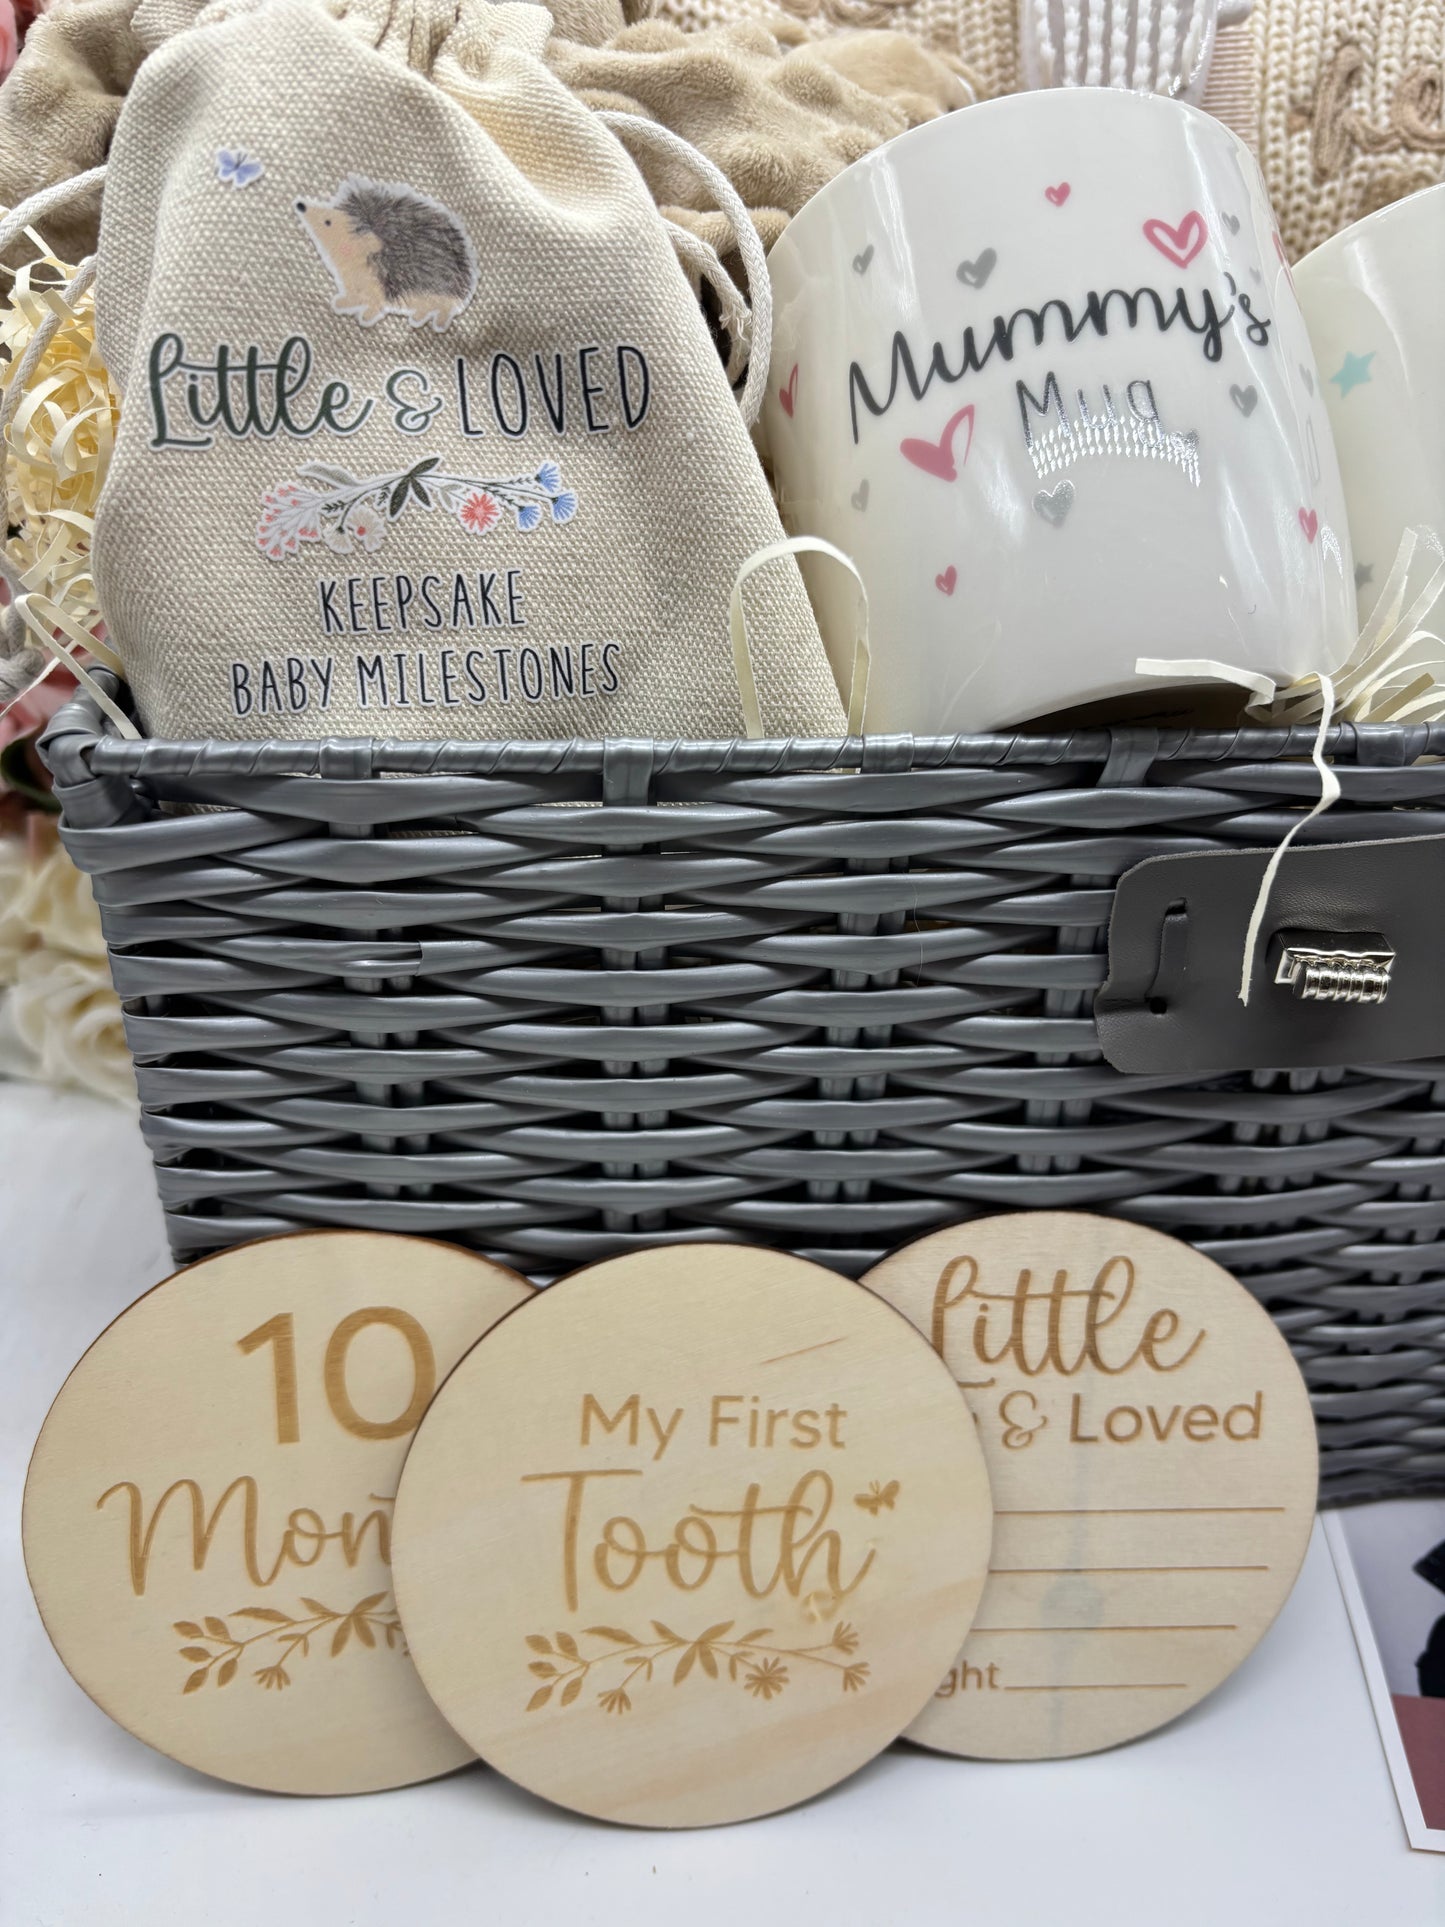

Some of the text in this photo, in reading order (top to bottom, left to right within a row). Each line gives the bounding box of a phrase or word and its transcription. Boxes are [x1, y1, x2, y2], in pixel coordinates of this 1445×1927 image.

[149, 332, 649, 448] Little & LOVED
[850, 272, 1271, 444] Mummy's
[1016, 371, 1166, 450] Mug
[320, 569, 525, 632] KEEPSAKE
[232, 643, 621, 714] BABY MILESTONES
[931, 1255, 1206, 1388] Little
[237, 1305, 436, 1445] 10
[999, 1389, 1264, 1450] & Loved
[580, 1393, 848, 1460] My First
[97, 1475, 396, 1596] Mon
[520, 1469, 876, 1612] Tooth
[934, 1660, 1000, 1698] ght
